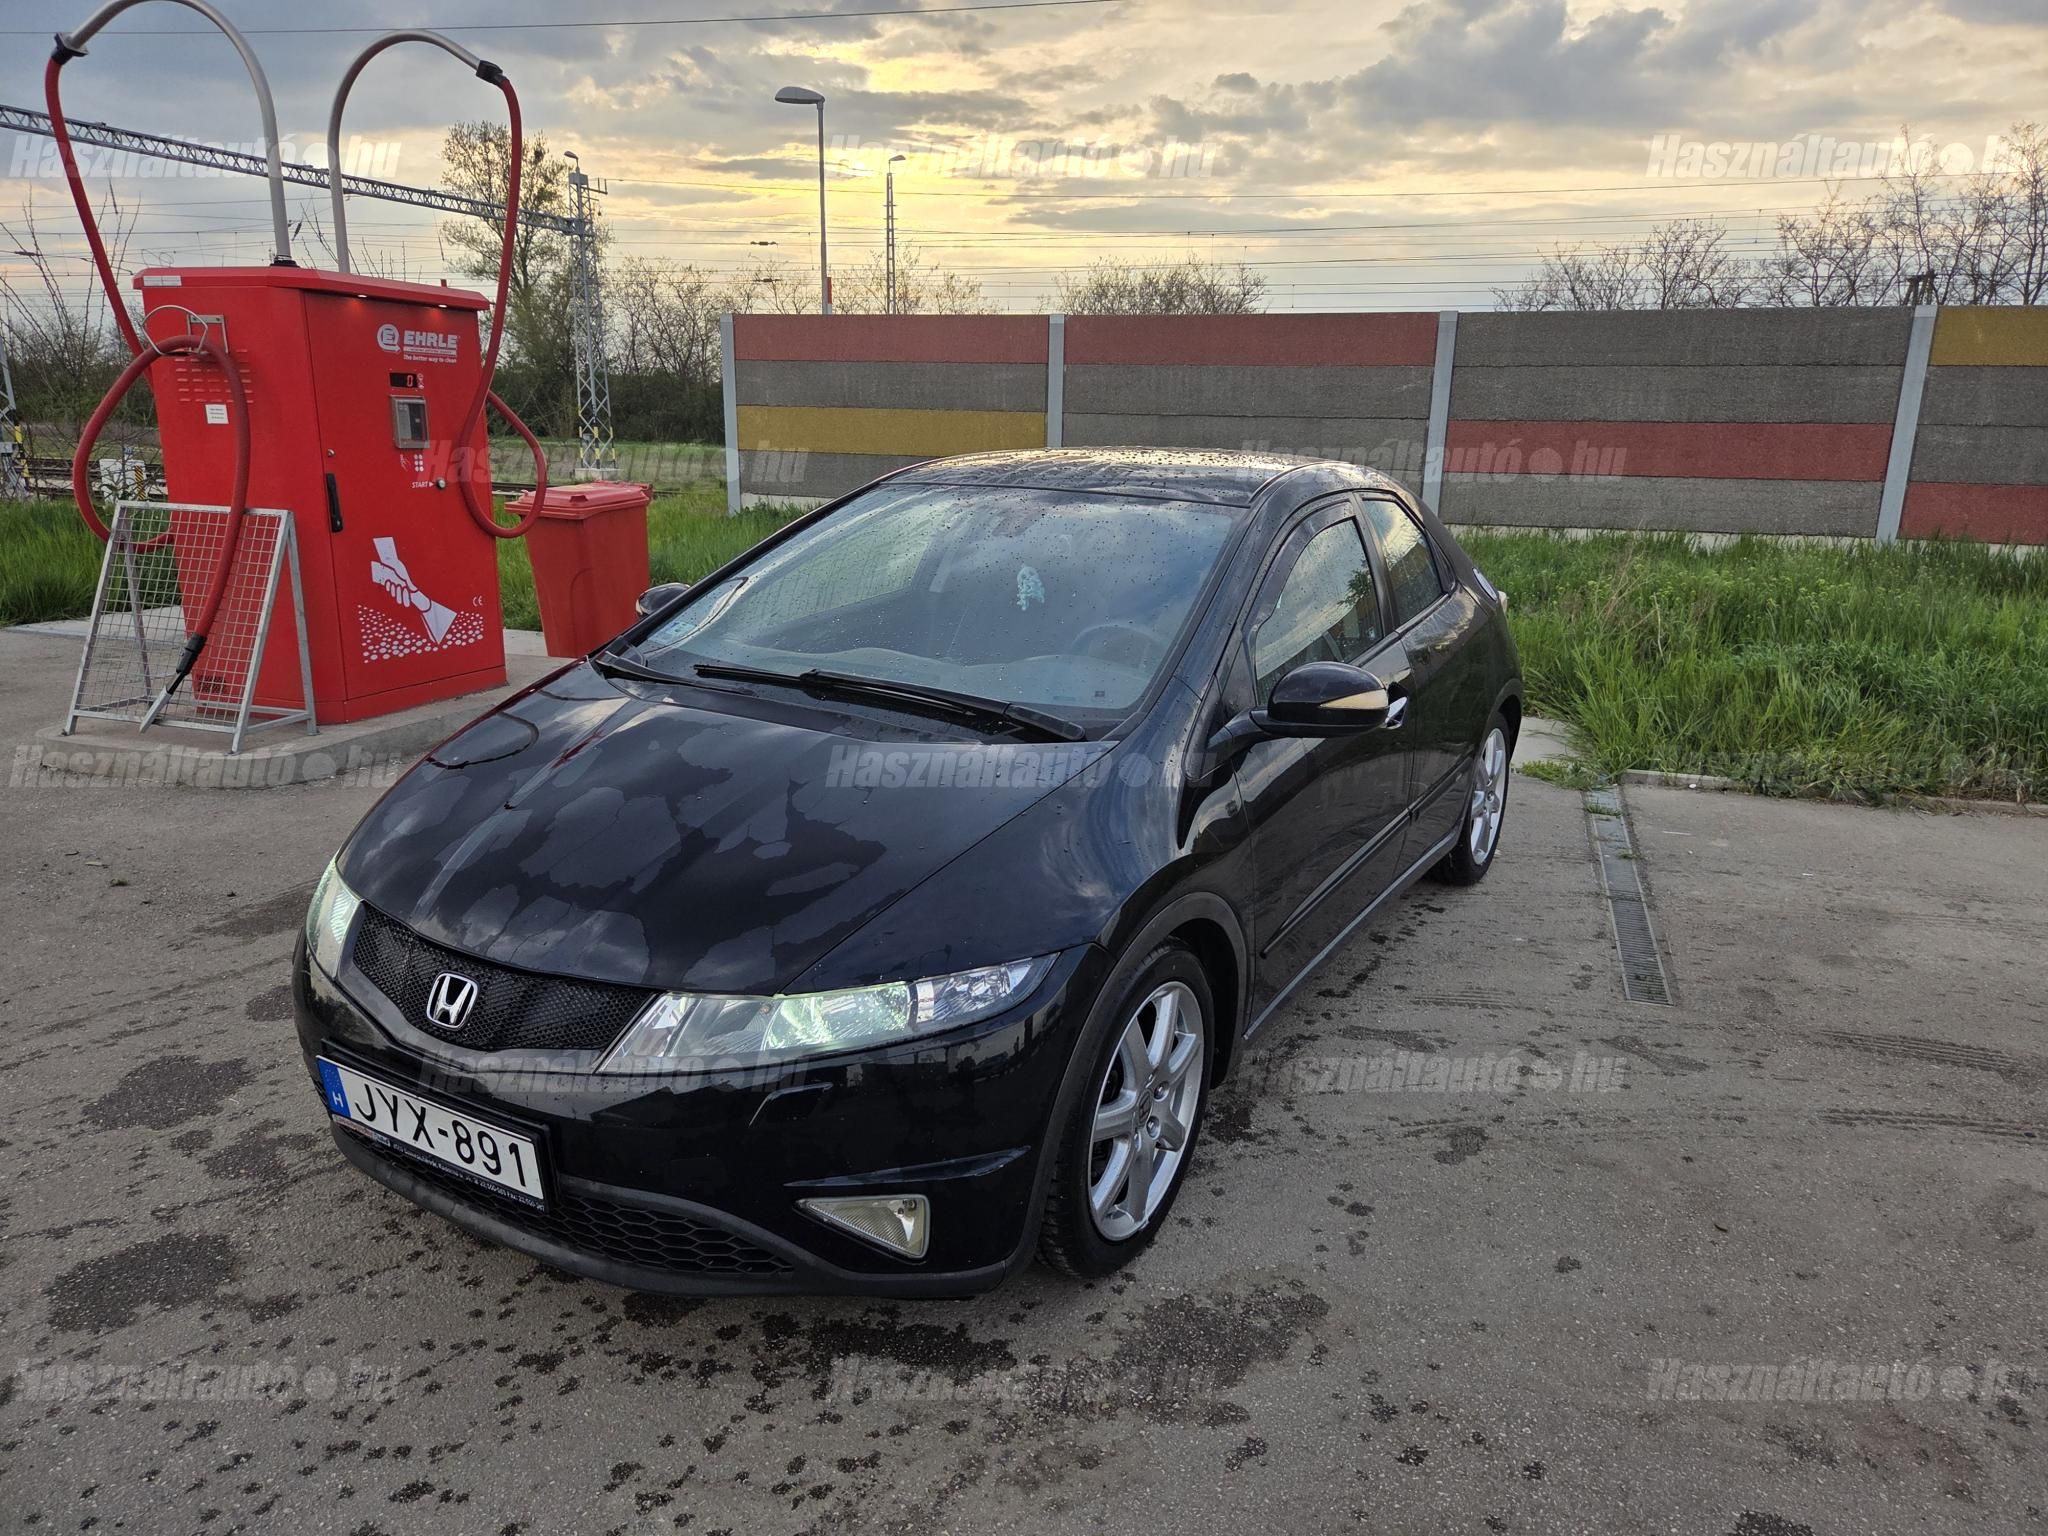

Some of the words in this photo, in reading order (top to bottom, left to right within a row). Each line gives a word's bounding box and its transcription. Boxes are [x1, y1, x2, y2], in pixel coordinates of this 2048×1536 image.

[403, 330, 457, 349] EHRLE
[411, 481, 428, 489] START
[355, 1083, 527, 1188] JYX-891
